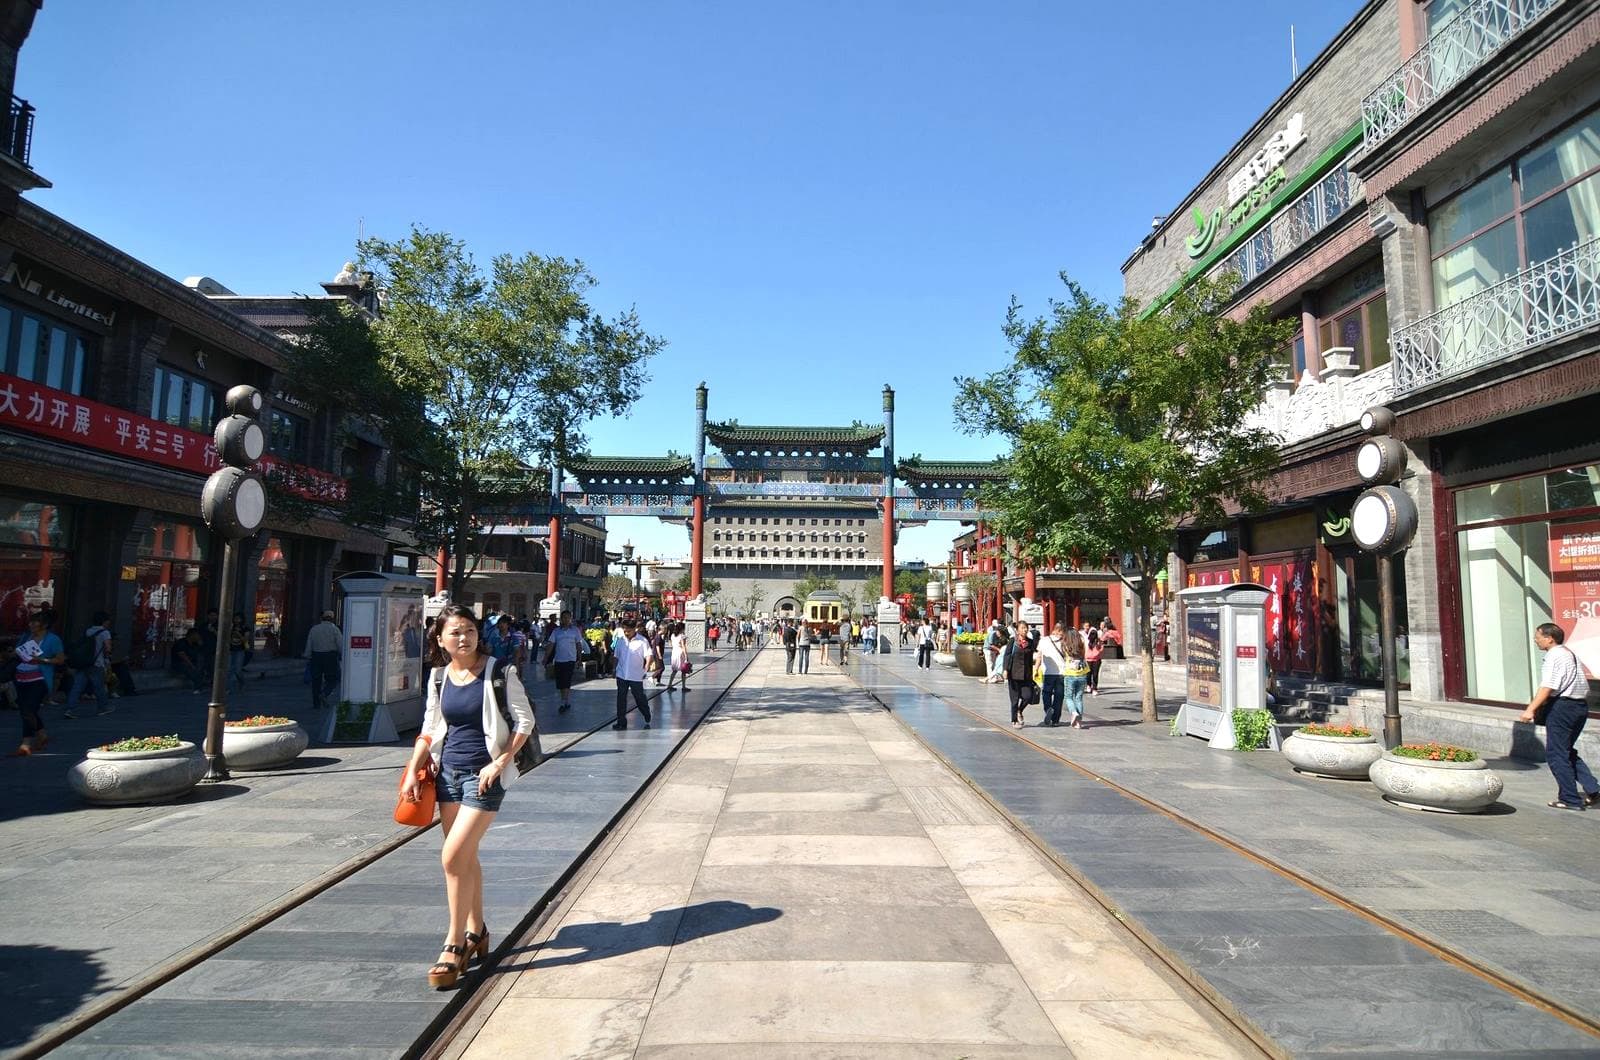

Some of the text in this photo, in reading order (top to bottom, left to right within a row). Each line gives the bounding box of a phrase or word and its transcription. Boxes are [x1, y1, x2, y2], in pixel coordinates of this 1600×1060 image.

[0, 383, 222, 469] 大力开展“平安三号”行
[1559, 544, 1600, 558] 大型折扣
